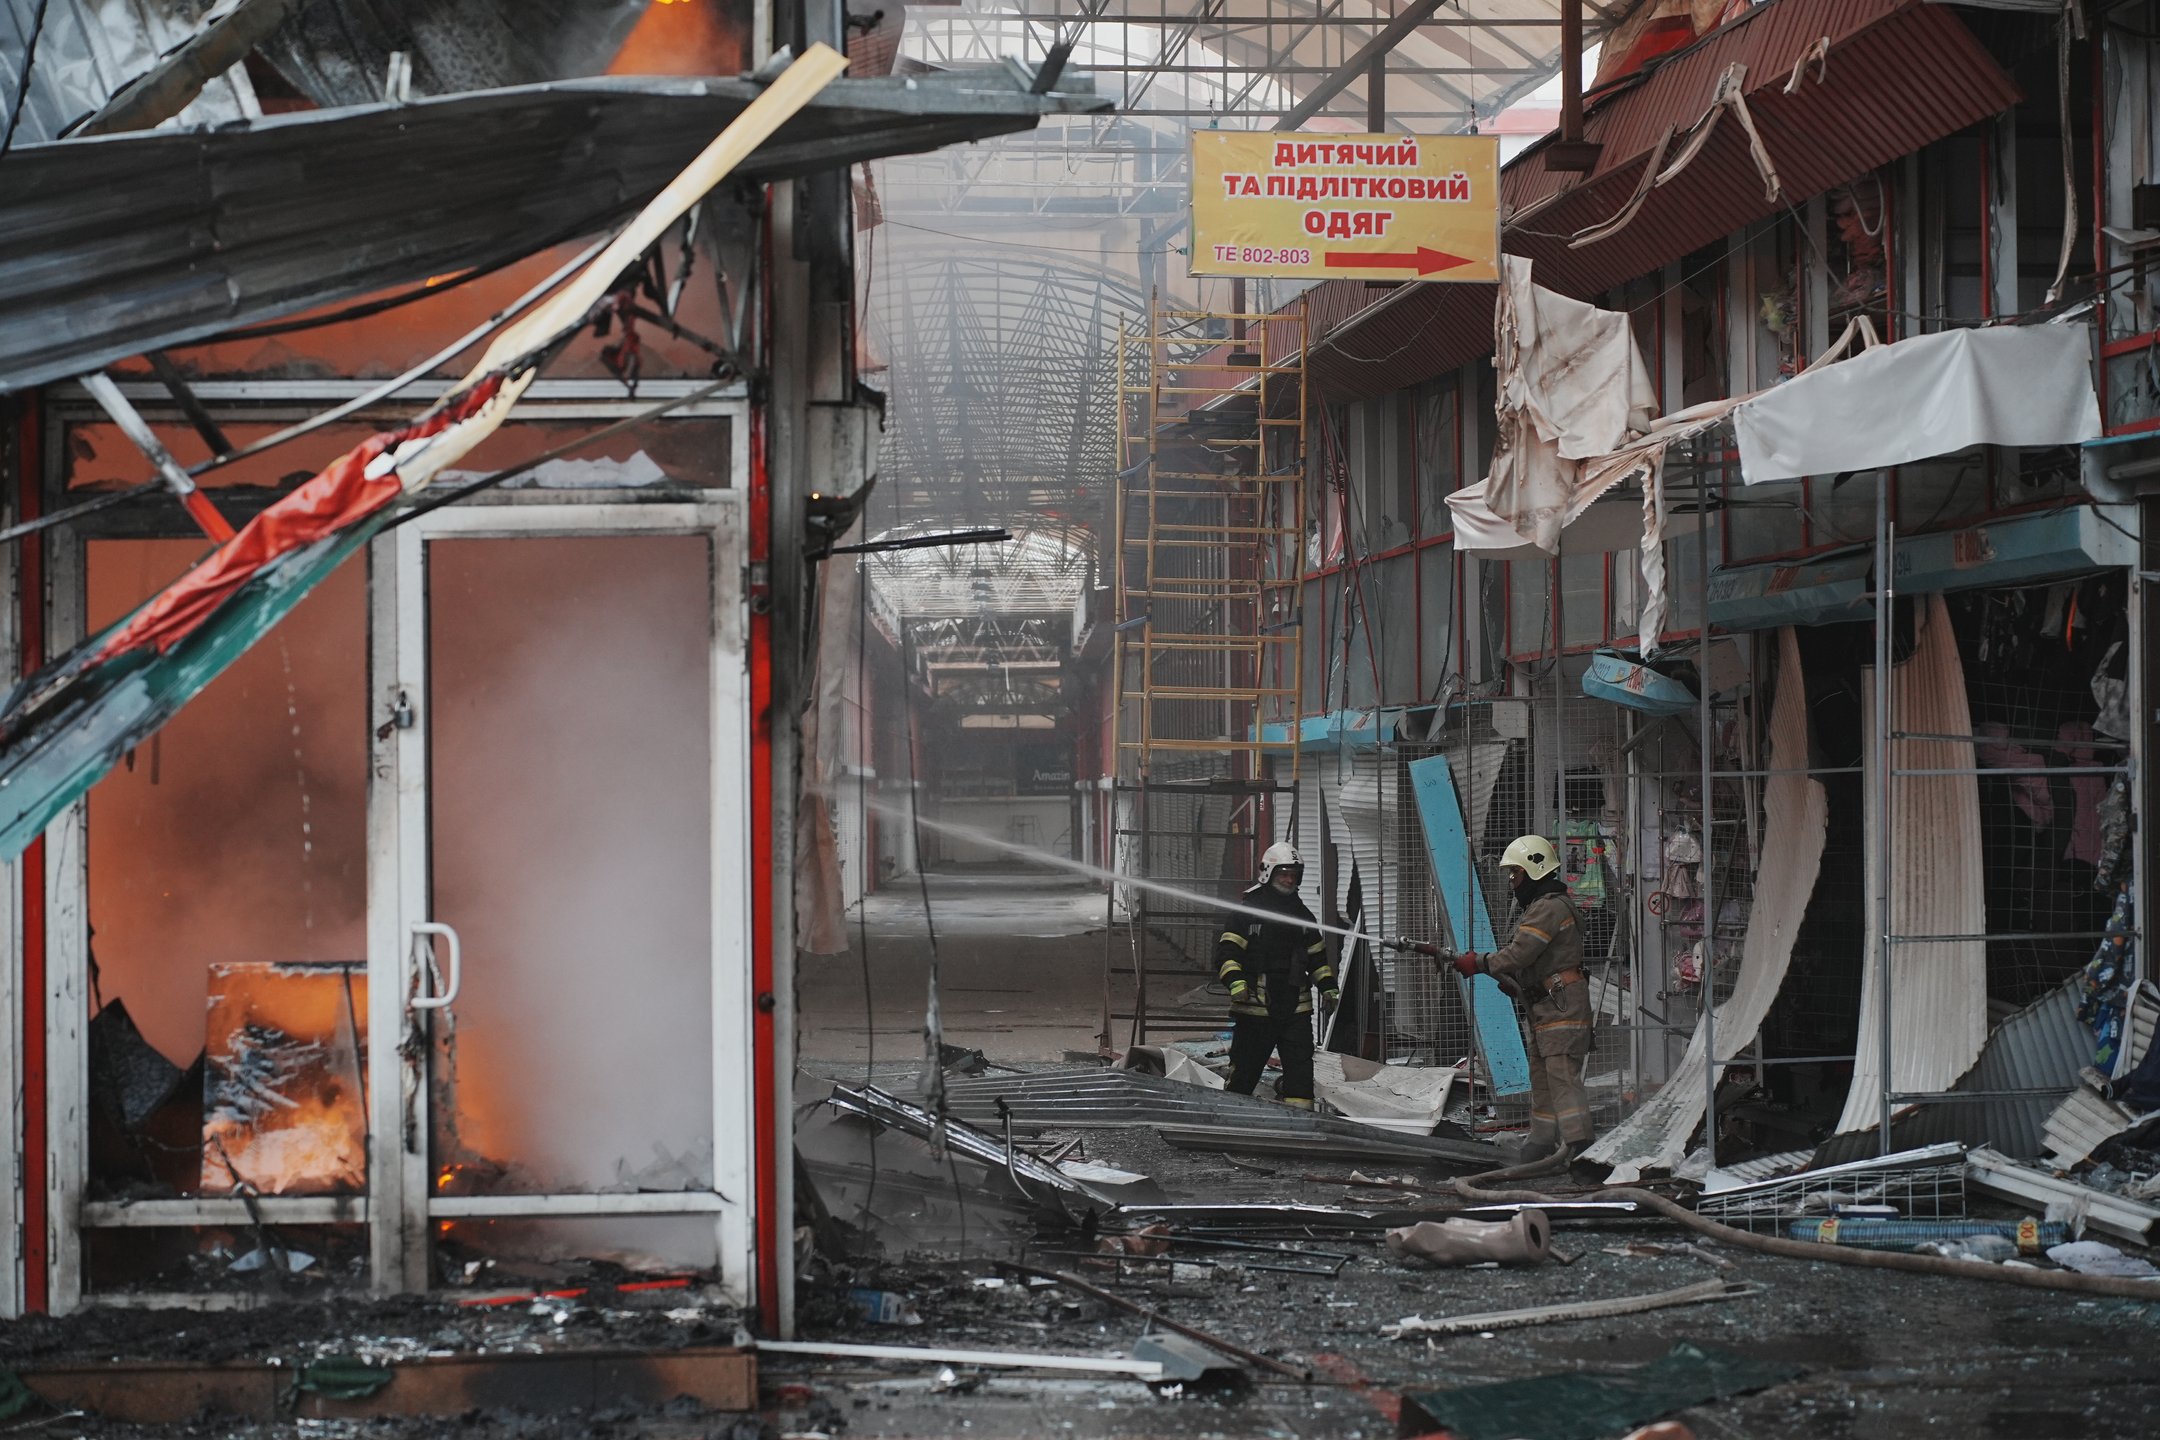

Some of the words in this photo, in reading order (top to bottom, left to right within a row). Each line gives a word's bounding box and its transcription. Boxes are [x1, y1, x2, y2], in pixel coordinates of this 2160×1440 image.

[1275, 139, 1417, 167] ДИТЯЧИЙ
[1224, 175, 1261, 196] ТА
[1267, 173, 1469, 200] ПІДЛІТКОВИЙ
[1304, 210, 1392, 239] ОДЯГ
[1214, 246, 1237, 262] ТЕ
[1242, 247, 1310, 264] 802-803
